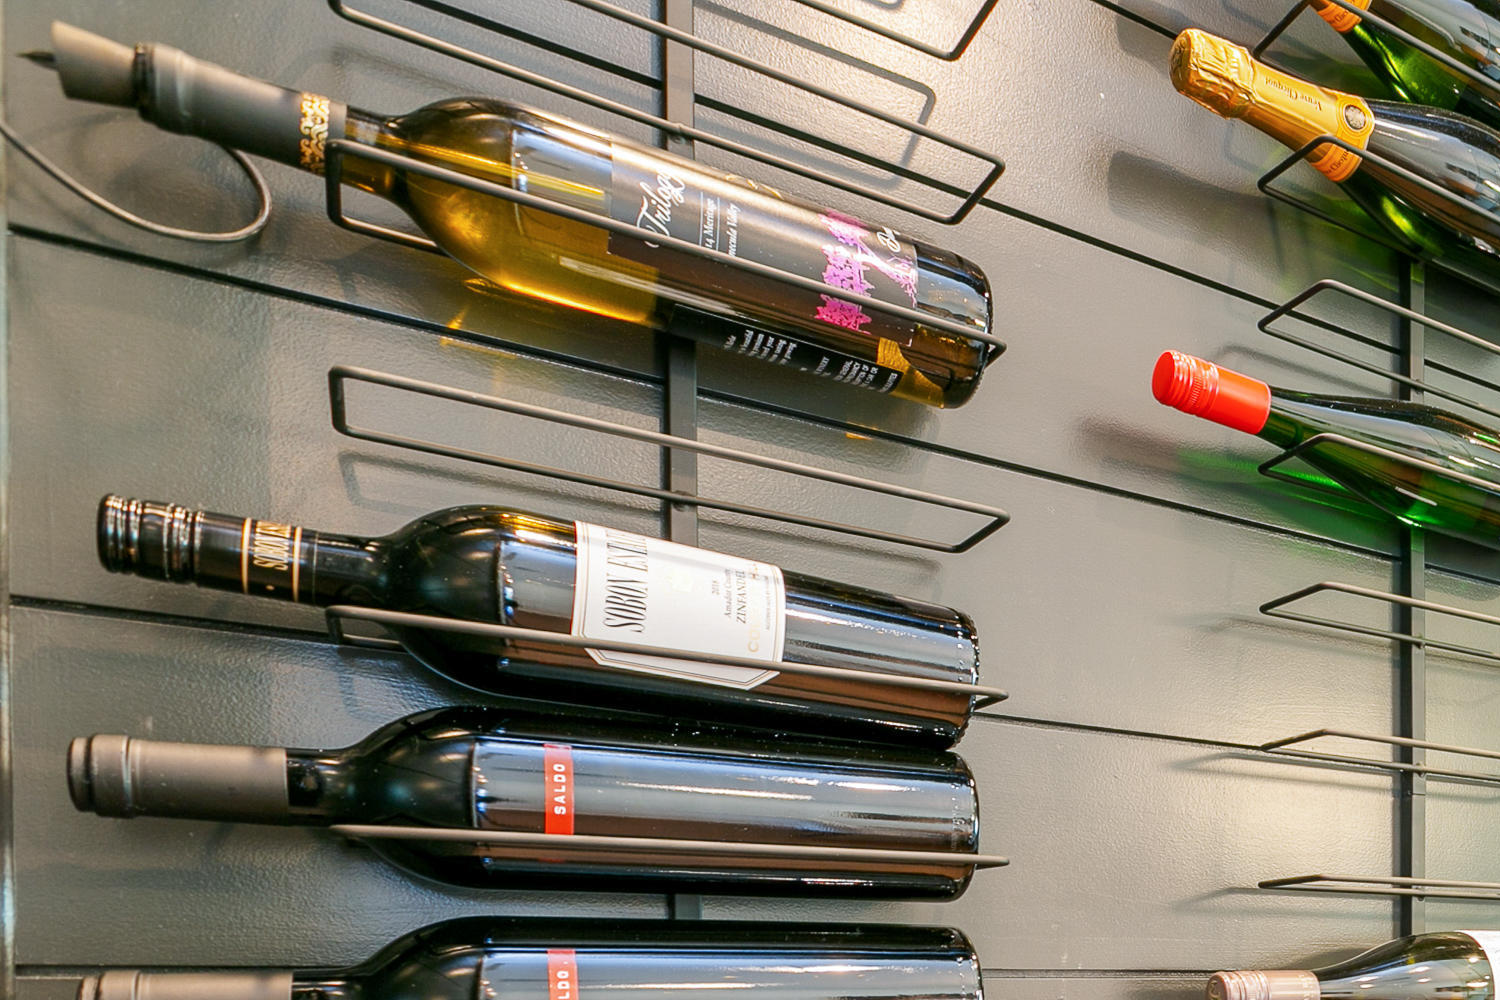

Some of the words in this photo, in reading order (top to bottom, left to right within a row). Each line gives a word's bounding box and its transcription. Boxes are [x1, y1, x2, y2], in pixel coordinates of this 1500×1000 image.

[602, 572, 649, 633] SOBON
[736, 570, 747, 624] ZINFANDEL
[553, 763, 567, 815] SALDO
